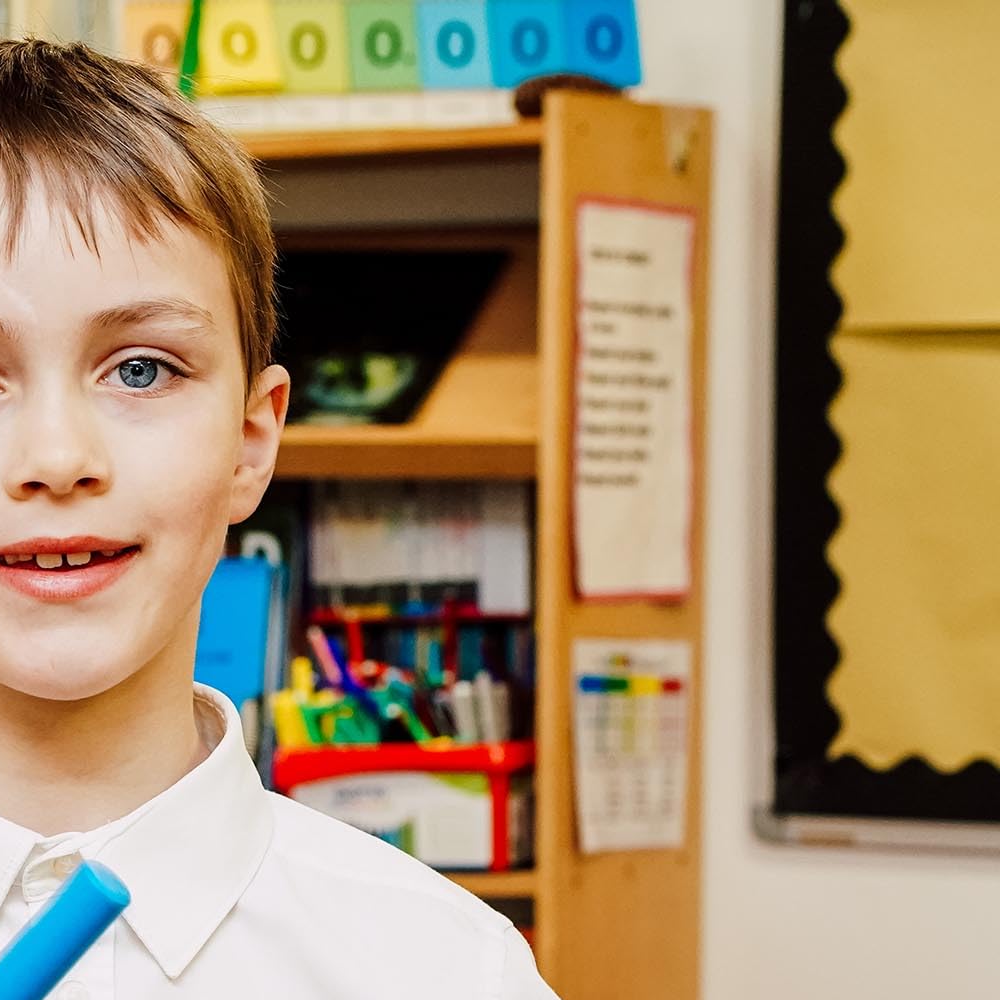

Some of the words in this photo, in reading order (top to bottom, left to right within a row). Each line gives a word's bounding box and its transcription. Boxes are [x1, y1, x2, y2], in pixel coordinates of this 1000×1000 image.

[221, 21, 257, 66] 0
[289, 20, 327, 70] 0
[436, 20, 475, 68] 0
[511, 18, 548, 66] 0
[585, 13, 623, 63] 0
